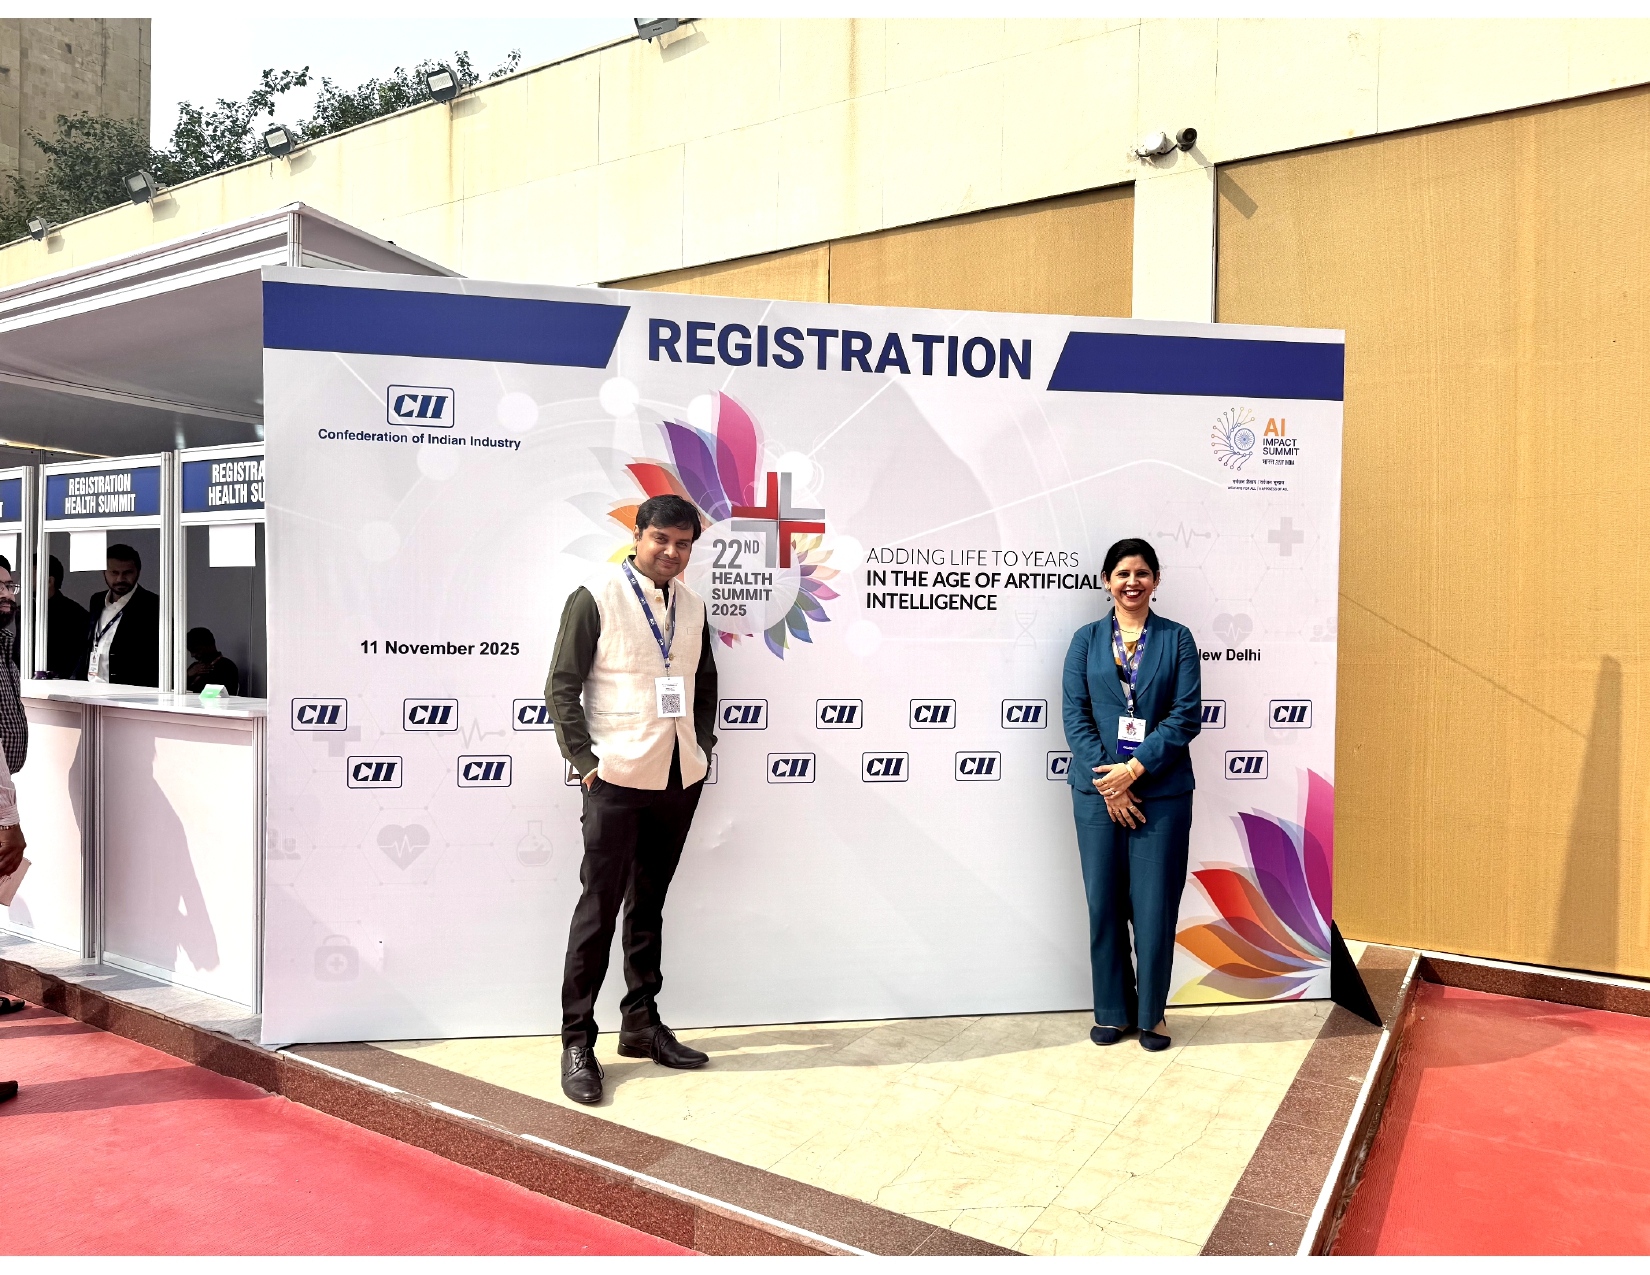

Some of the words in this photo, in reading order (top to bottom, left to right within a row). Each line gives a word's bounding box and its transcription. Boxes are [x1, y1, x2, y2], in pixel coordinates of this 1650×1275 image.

[649, 318, 1031, 380] REGISTRATION
[394, 394, 449, 419] CII
[1263, 418, 1286, 437] AI
[318, 428, 408, 443] Confederation
[412, 433, 425, 444] of
[427, 433, 466, 446] Indian
[470, 435, 521, 451] Industry
[1262, 438, 1298, 447] IMPACT
[1262, 447, 1300, 456] SUMMIT
[68, 473, 131, 496] REGISTRATION
[64, 496, 97, 515] HEALTH
[98, 493, 136, 513] SUMMIT
[208, 484, 248, 506] HEALTH
[712, 539, 760, 570] 22ND
[866, 547, 945, 566] ADDING
[950, 549, 987, 567] LIFE
[991, 550, 1018, 567] TO
[1021, 550, 1080, 568] YEARS
[711, 571, 773, 586] HEALTH
[866, 570, 887, 587] IN
[891, 570, 929, 588] THE
[932, 571, 971, 588] AGE
[975, 572, 1001, 589] OF
[1004, 572, 1102, 590] ARTIFICIAL
[711, 587, 773, 602] SUMMIT
[866, 592, 998, 611] INTELLIGENCE
[711, 603, 748, 617] 2025
[360, 640, 377, 654] 11
[385, 641, 475, 655] November
[479, 641, 520, 656] 2025
[1226, 648, 1261, 662] Delhi
[297, 704, 342, 725] CII
[409, 705, 454, 725] CII
[723, 705, 764, 724] CII
[820, 705, 859, 724] CII
[913, 705, 952, 723] CII
[1006, 705, 1044, 723] CII
[1273, 705, 1309, 722] CII
[352, 762, 398, 782] CII
[462, 761, 507, 781] CII
[771, 758, 812, 778] CII
[866, 758, 904, 777] CII
[959, 757, 997, 775] CII
[1228, 756, 1265, 774] CII
